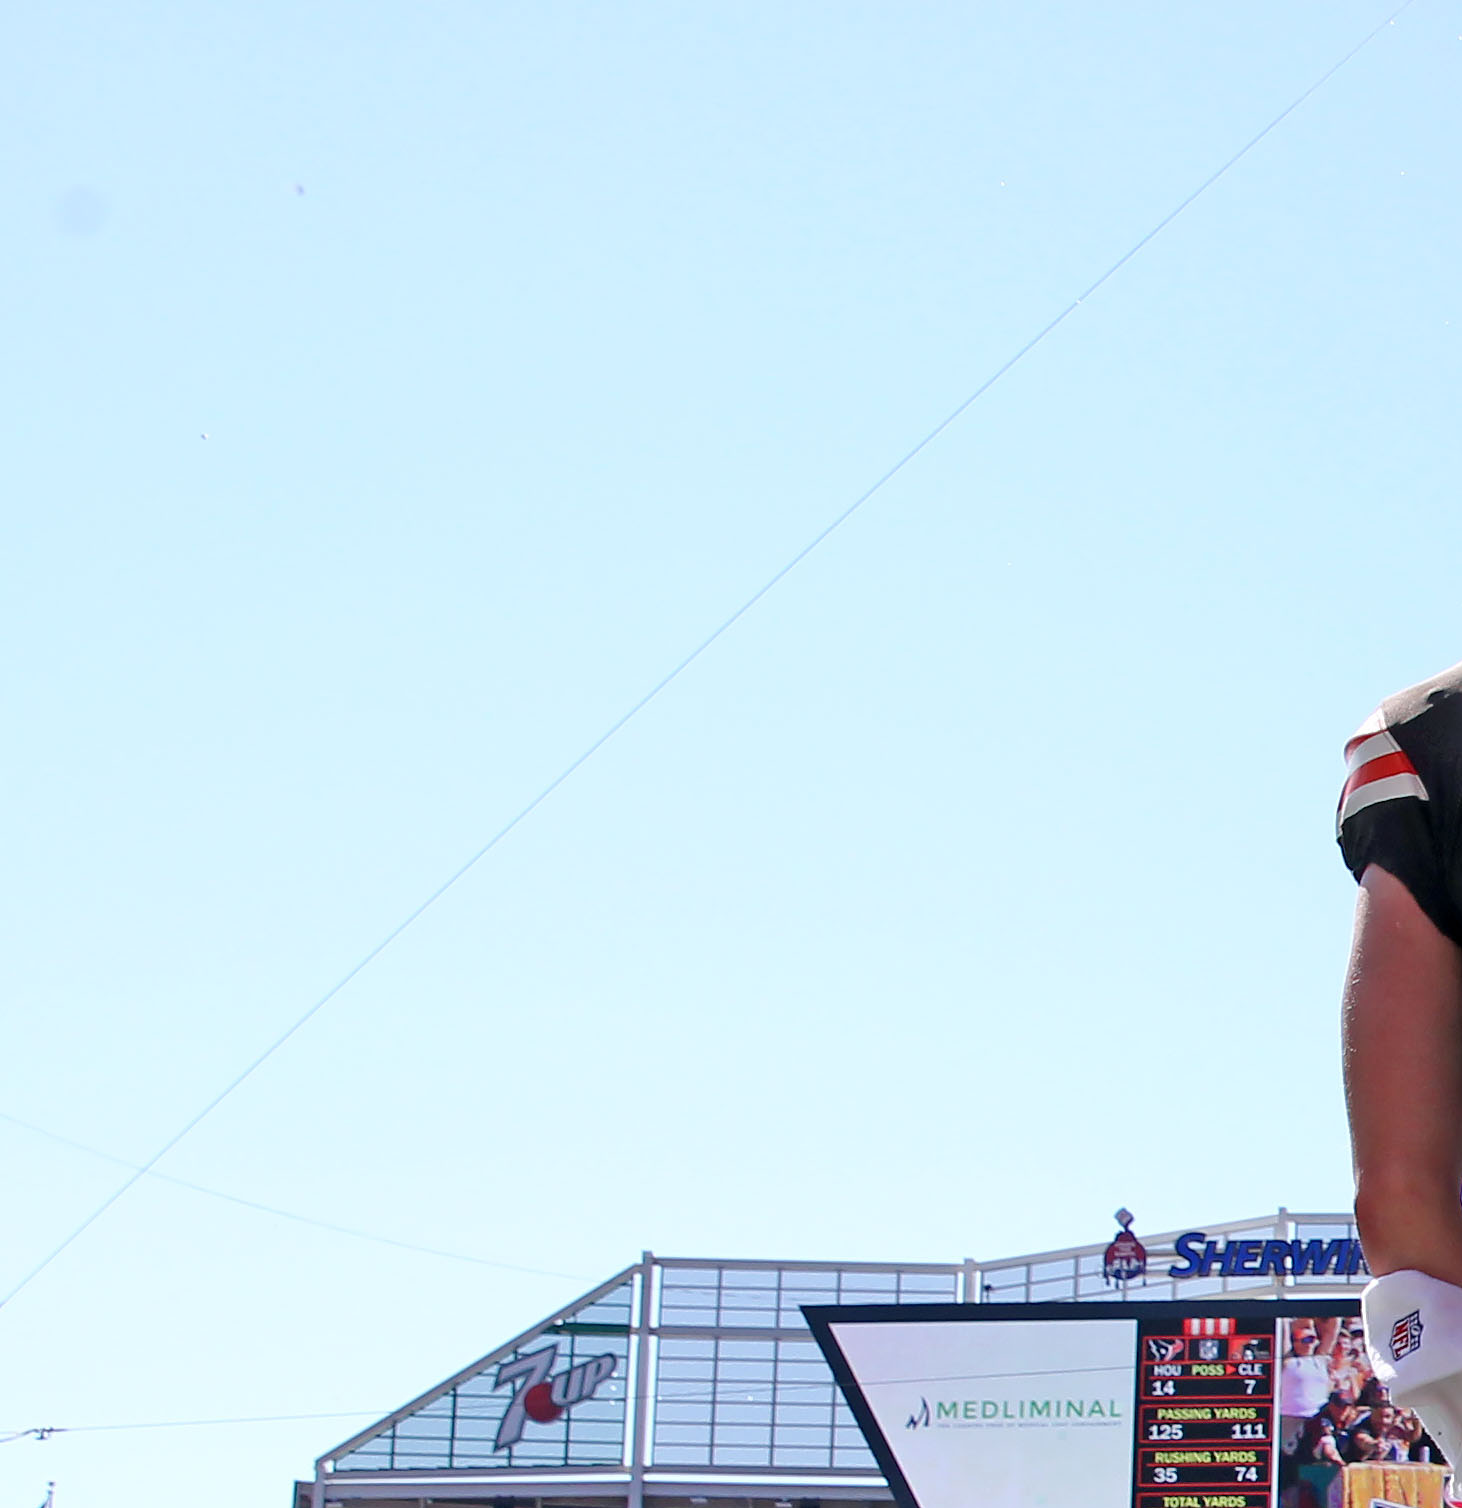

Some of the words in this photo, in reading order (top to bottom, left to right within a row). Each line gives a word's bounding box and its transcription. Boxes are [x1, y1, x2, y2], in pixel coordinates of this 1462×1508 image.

[1153, 1365, 1182, 1377] HOU
[1191, 1364, 1225, 1376] POSS
[1237, 1363, 1263, 1376] CLE
[1152, 1380, 1175, 1396] 14
[1244, 1379, 1256, 1395] 7
[937, 1400, 1123, 1419] MEDLIMINAL
[1157, 1408, 1212, 1420] PASSING
[1213, 1407, 1257, 1419] YARDS
[1148, 1424, 1183, 1440] 125
[1231, 1423, 1266, 1440] 111
[1154, 1451, 1211, 1463] RUSHING
[1213, 1450, 1257, 1463] YARDS
[1153, 1467, 1178, 1483] 35
[1234, 1466, 1258, 1482] 74
[1162, 1496, 1201, 1508] TOTAL
[1202, 1496, 1247, 1508] YARDS
